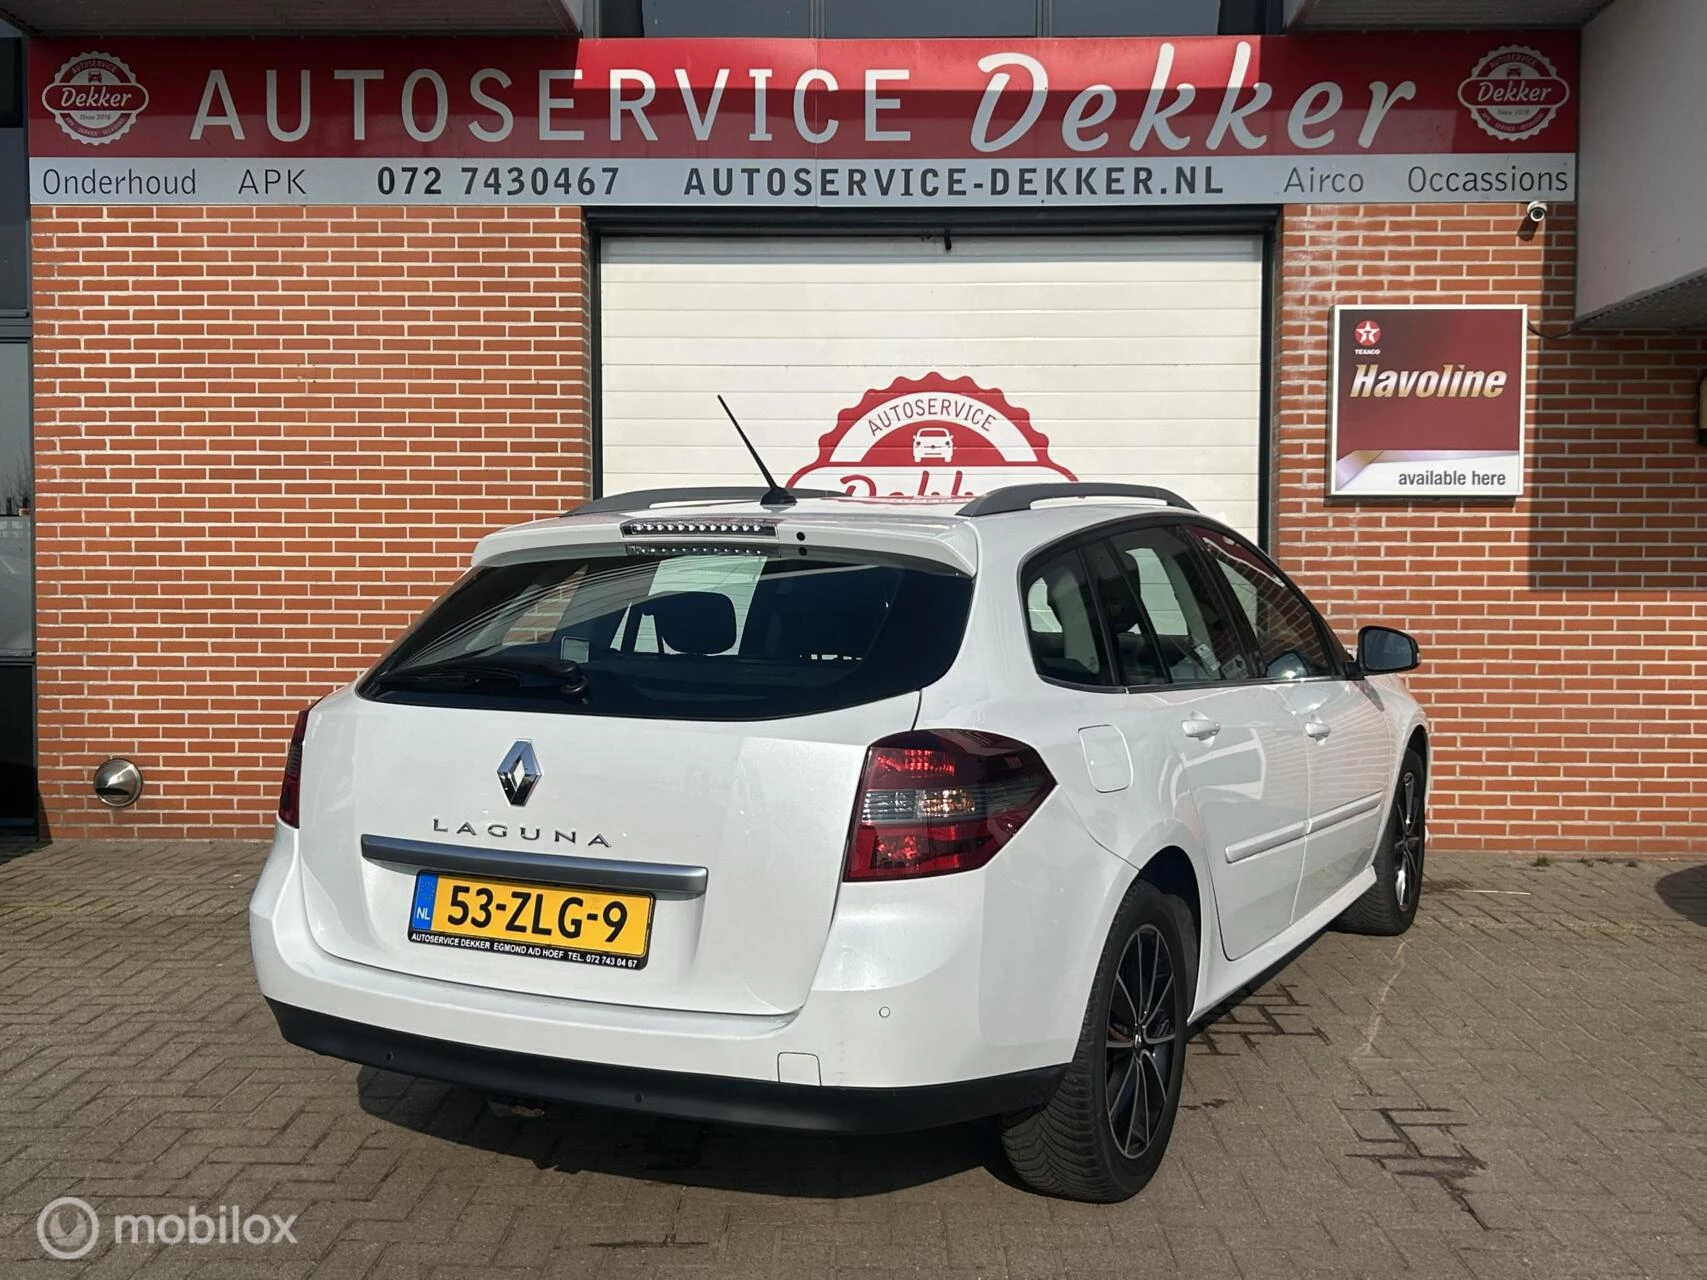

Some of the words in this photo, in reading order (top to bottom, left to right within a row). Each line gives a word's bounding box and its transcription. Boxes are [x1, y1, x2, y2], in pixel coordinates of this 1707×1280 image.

[71, 60, 118, 74] AUTOSERVICE
[61, 86, 132, 107] Dekker
[190, 68, 911, 143] AUTOSERVICE
[970, 41, 1416, 153] Dekker
[1478, 80, 1552, 102] Dekker
[42, 168, 196, 195] Onderhoud
[238, 168, 307, 195] APK
[377, 167, 443, 195] 072
[461, 166, 619, 195] 7430467
[684, 166, 1224, 197] AUTOSERVICE-DEKKER.NL
[1283, 166, 1364, 193] Airco
[1407, 165, 1568, 192] Occassions
[1350, 364, 1507, 398] Havoline
[867, 398, 997, 437] AUTOSERVICE
[1398, 470, 1466, 486] available
[1472, 470, 1506, 486] here
[433, 818, 612, 848] LAGUNA
[416, 906, 430, 921] NL
[447, 885, 628, 943] 53-ZLG-9
[411, 933, 459, 946] AUTOSERVICE
[461, 938, 490, 949] DEKKER
[493, 942, 527, 954] EGMOND
[527, 946, 541, 956] A/D
[542, 949, 564, 959] HOEF
[568, 952, 584, 962] TEL.
[586, 954, 600, 964] 072
[601, 956, 615, 965] 743
[617, 958, 627, 967] 04
[627, 959, 638, 968] 67
